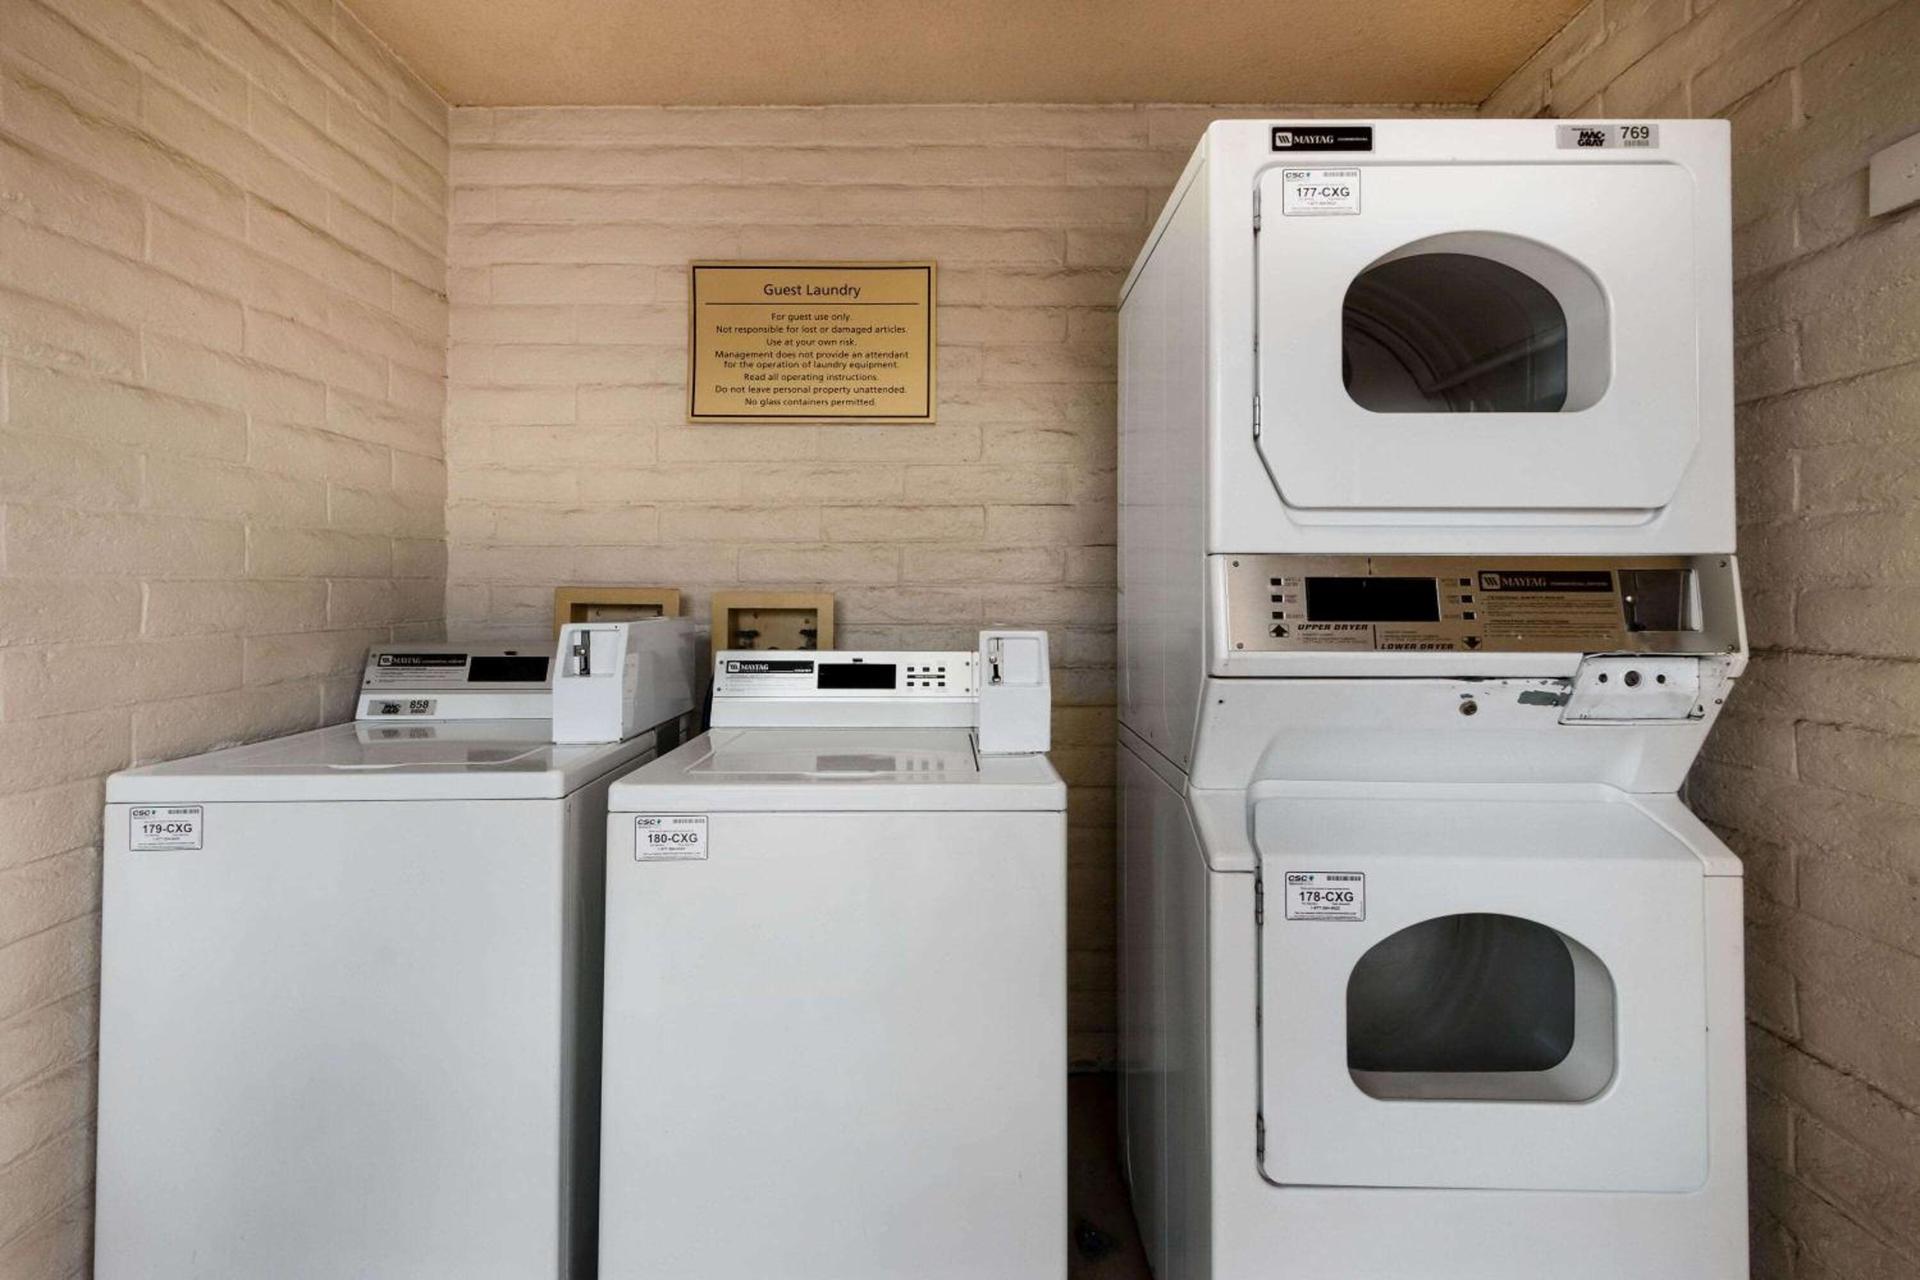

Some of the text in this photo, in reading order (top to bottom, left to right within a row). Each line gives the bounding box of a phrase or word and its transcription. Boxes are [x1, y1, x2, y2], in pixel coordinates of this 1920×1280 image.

[1620, 126, 1649, 139] 769
[1293, 135, 1334, 145] MAYTAG
[1577, 139, 1604, 147] GRAY
[1296, 187, 1350, 197] 177-CXG
[763, 284, 861, 299] Guest Laundry
[771, 313, 785, 321] For
[787, 314, 812, 323] guest
[716, 326, 733, 334] Not
[735, 325, 783, 335] responsible
[786, 325, 799, 334] for
[802, 325, 817, 334] lost
[831, 325, 873, 335] damaged
[715, 351, 773, 360] Management
[776, 351, 796, 359] does
[816, 351, 849, 360] provide
[865, 351, 909, 359] attendant
[756, 361, 800, 370] operation
[814, 361, 847, 370] laundry
[744, 373, 766, 381] Read
[781, 374, 824, 383] operating
[715, 385, 728, 393] Do
[748, 385, 771, 393] leave
[773, 385, 811, 395] personal
[813, 386, 851, 395] property
[760, 398, 781, 407] glass
[783, 398, 829, 406] containers
[1502, 577, 1546, 587] MAYTAG
[410, 700, 430, 709] 858
[143, 824, 193, 834] 179-CXG
[648, 833, 698, 843] 180-CXG
[1299, 891, 1354, 902] 178-CXG
